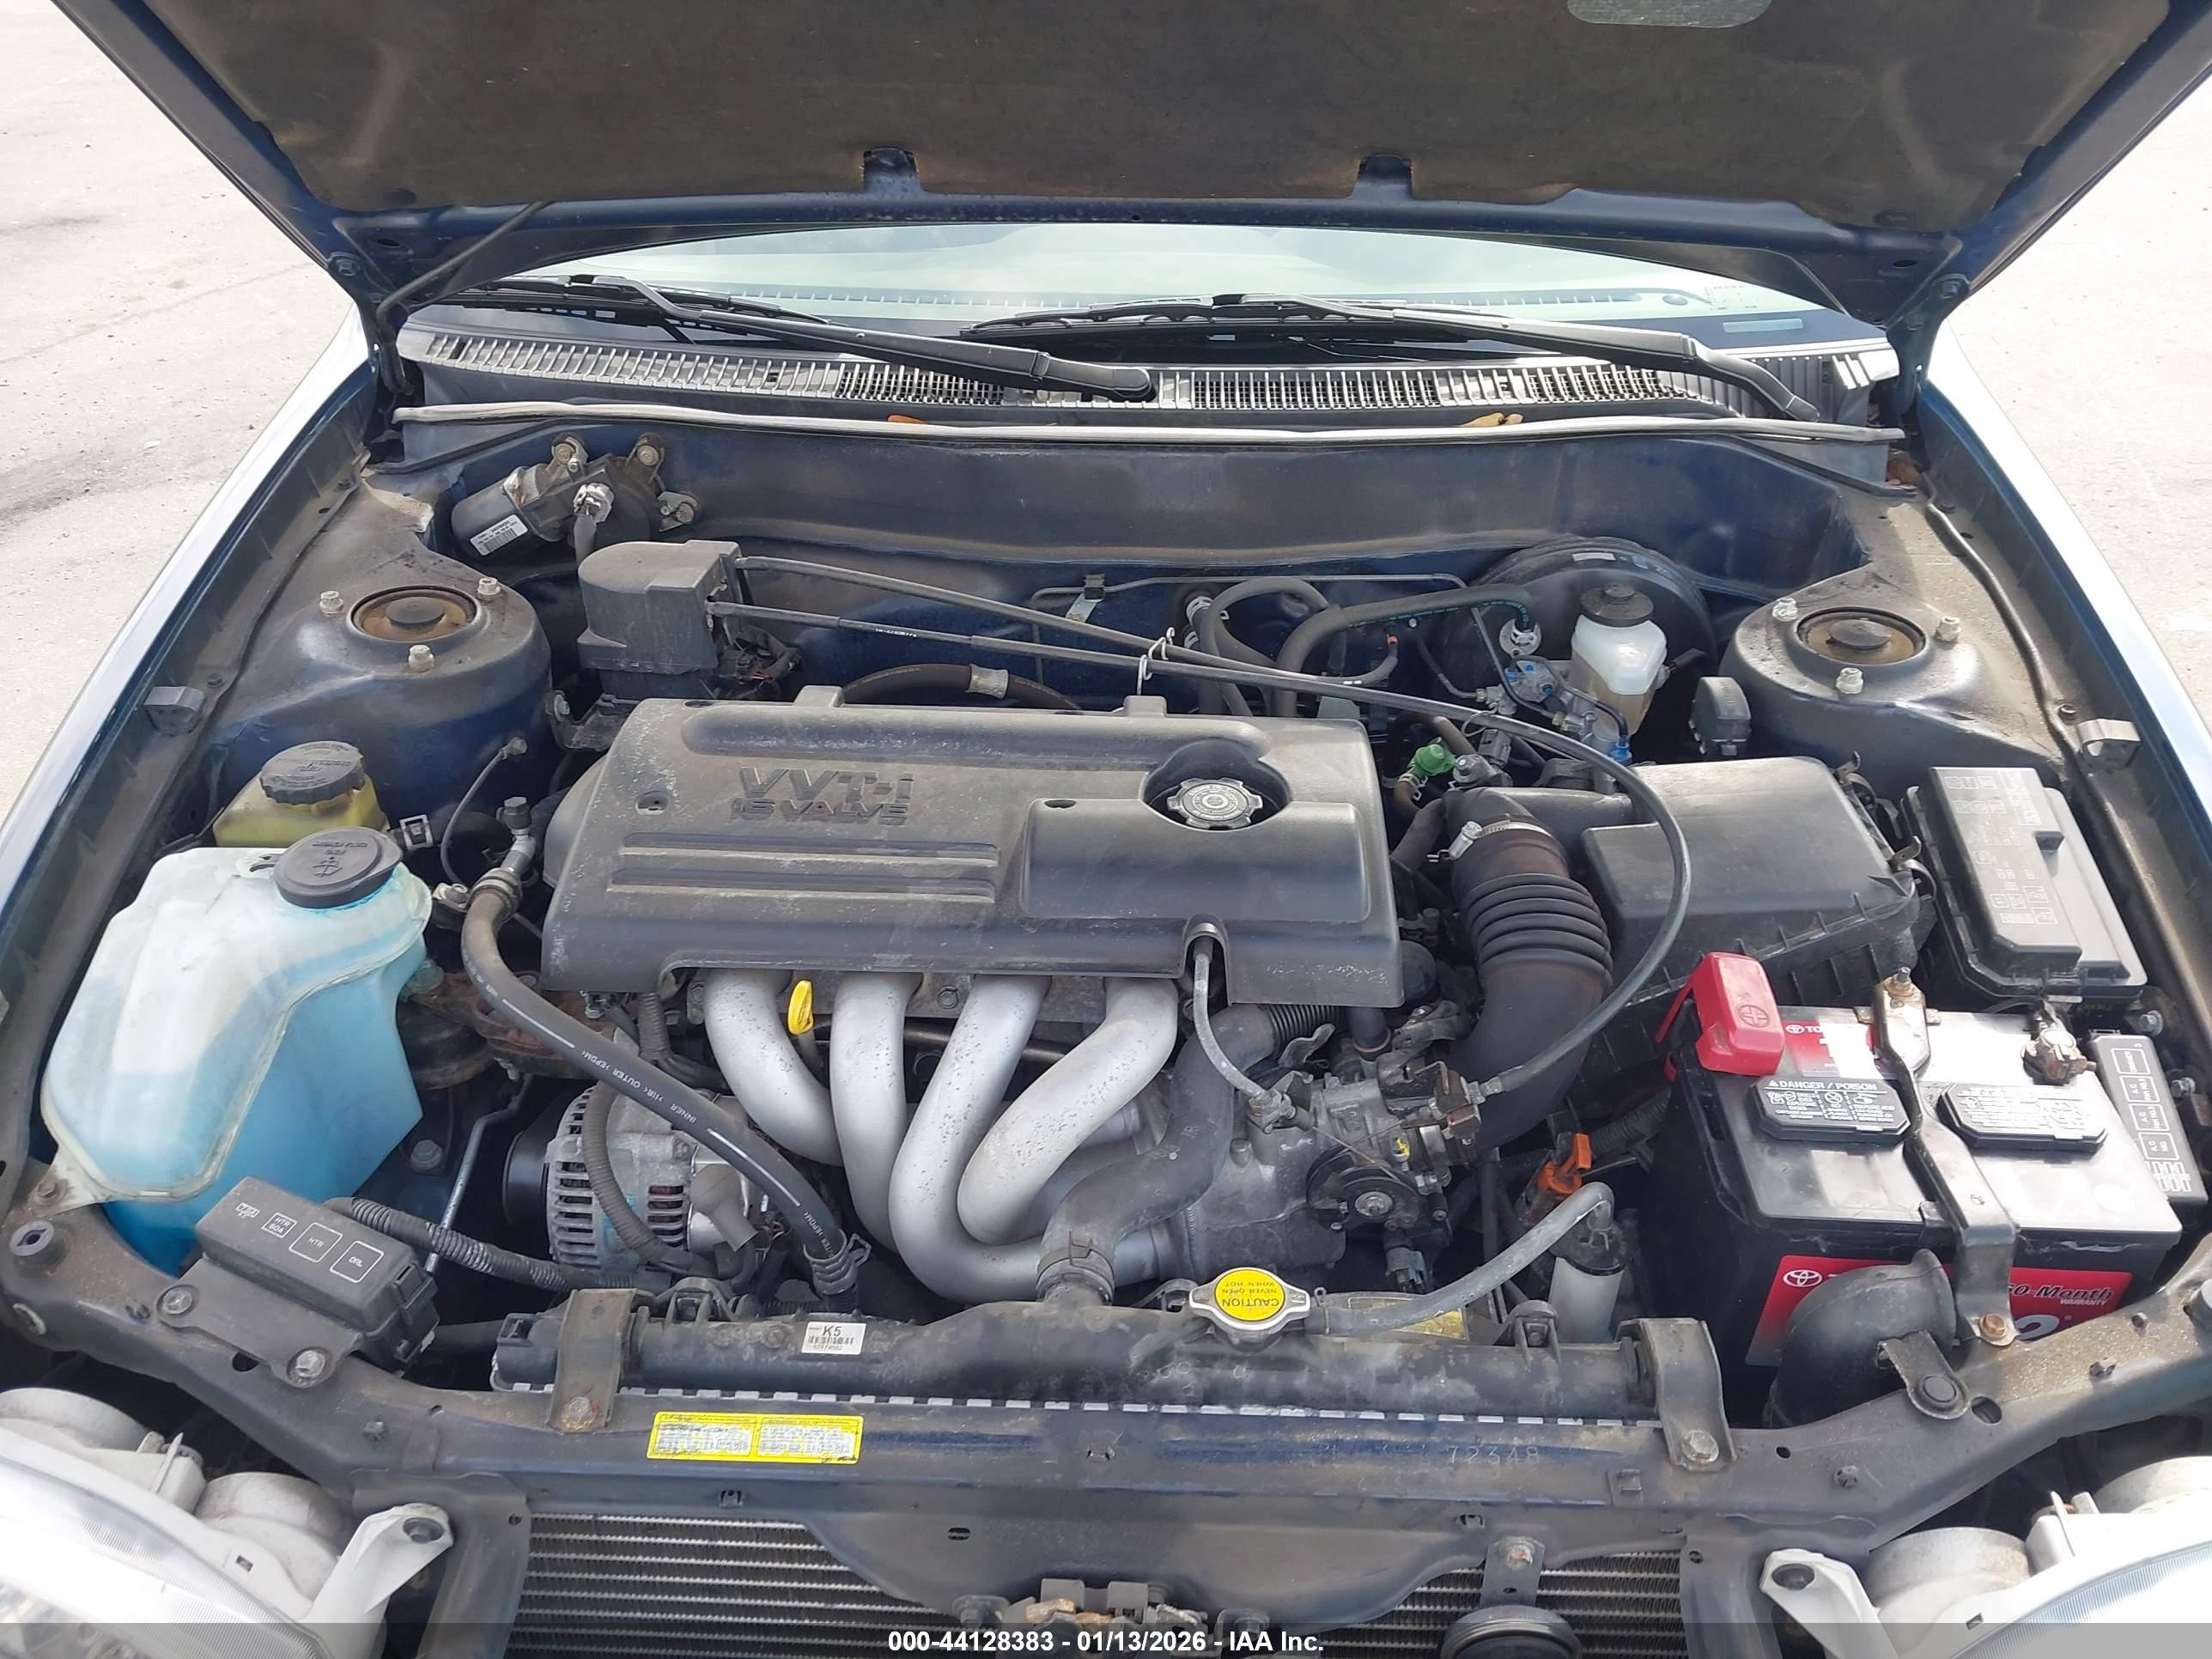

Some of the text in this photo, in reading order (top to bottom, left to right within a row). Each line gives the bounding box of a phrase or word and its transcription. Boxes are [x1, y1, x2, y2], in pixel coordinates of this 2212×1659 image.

[612, 1068, 641, 1089] OUTER
[1778, 1080, 1825, 1090] DANGER
[1836, 1082, 1878, 1091] POISON
[670, 1103, 697, 1124] INNER
[274, 1217, 291, 1227] HTR
[307, 1237, 325, 1249] HTR
[1222, 1297, 1279, 1307] CAUTION
[823, 1325, 842, 1337] K5
